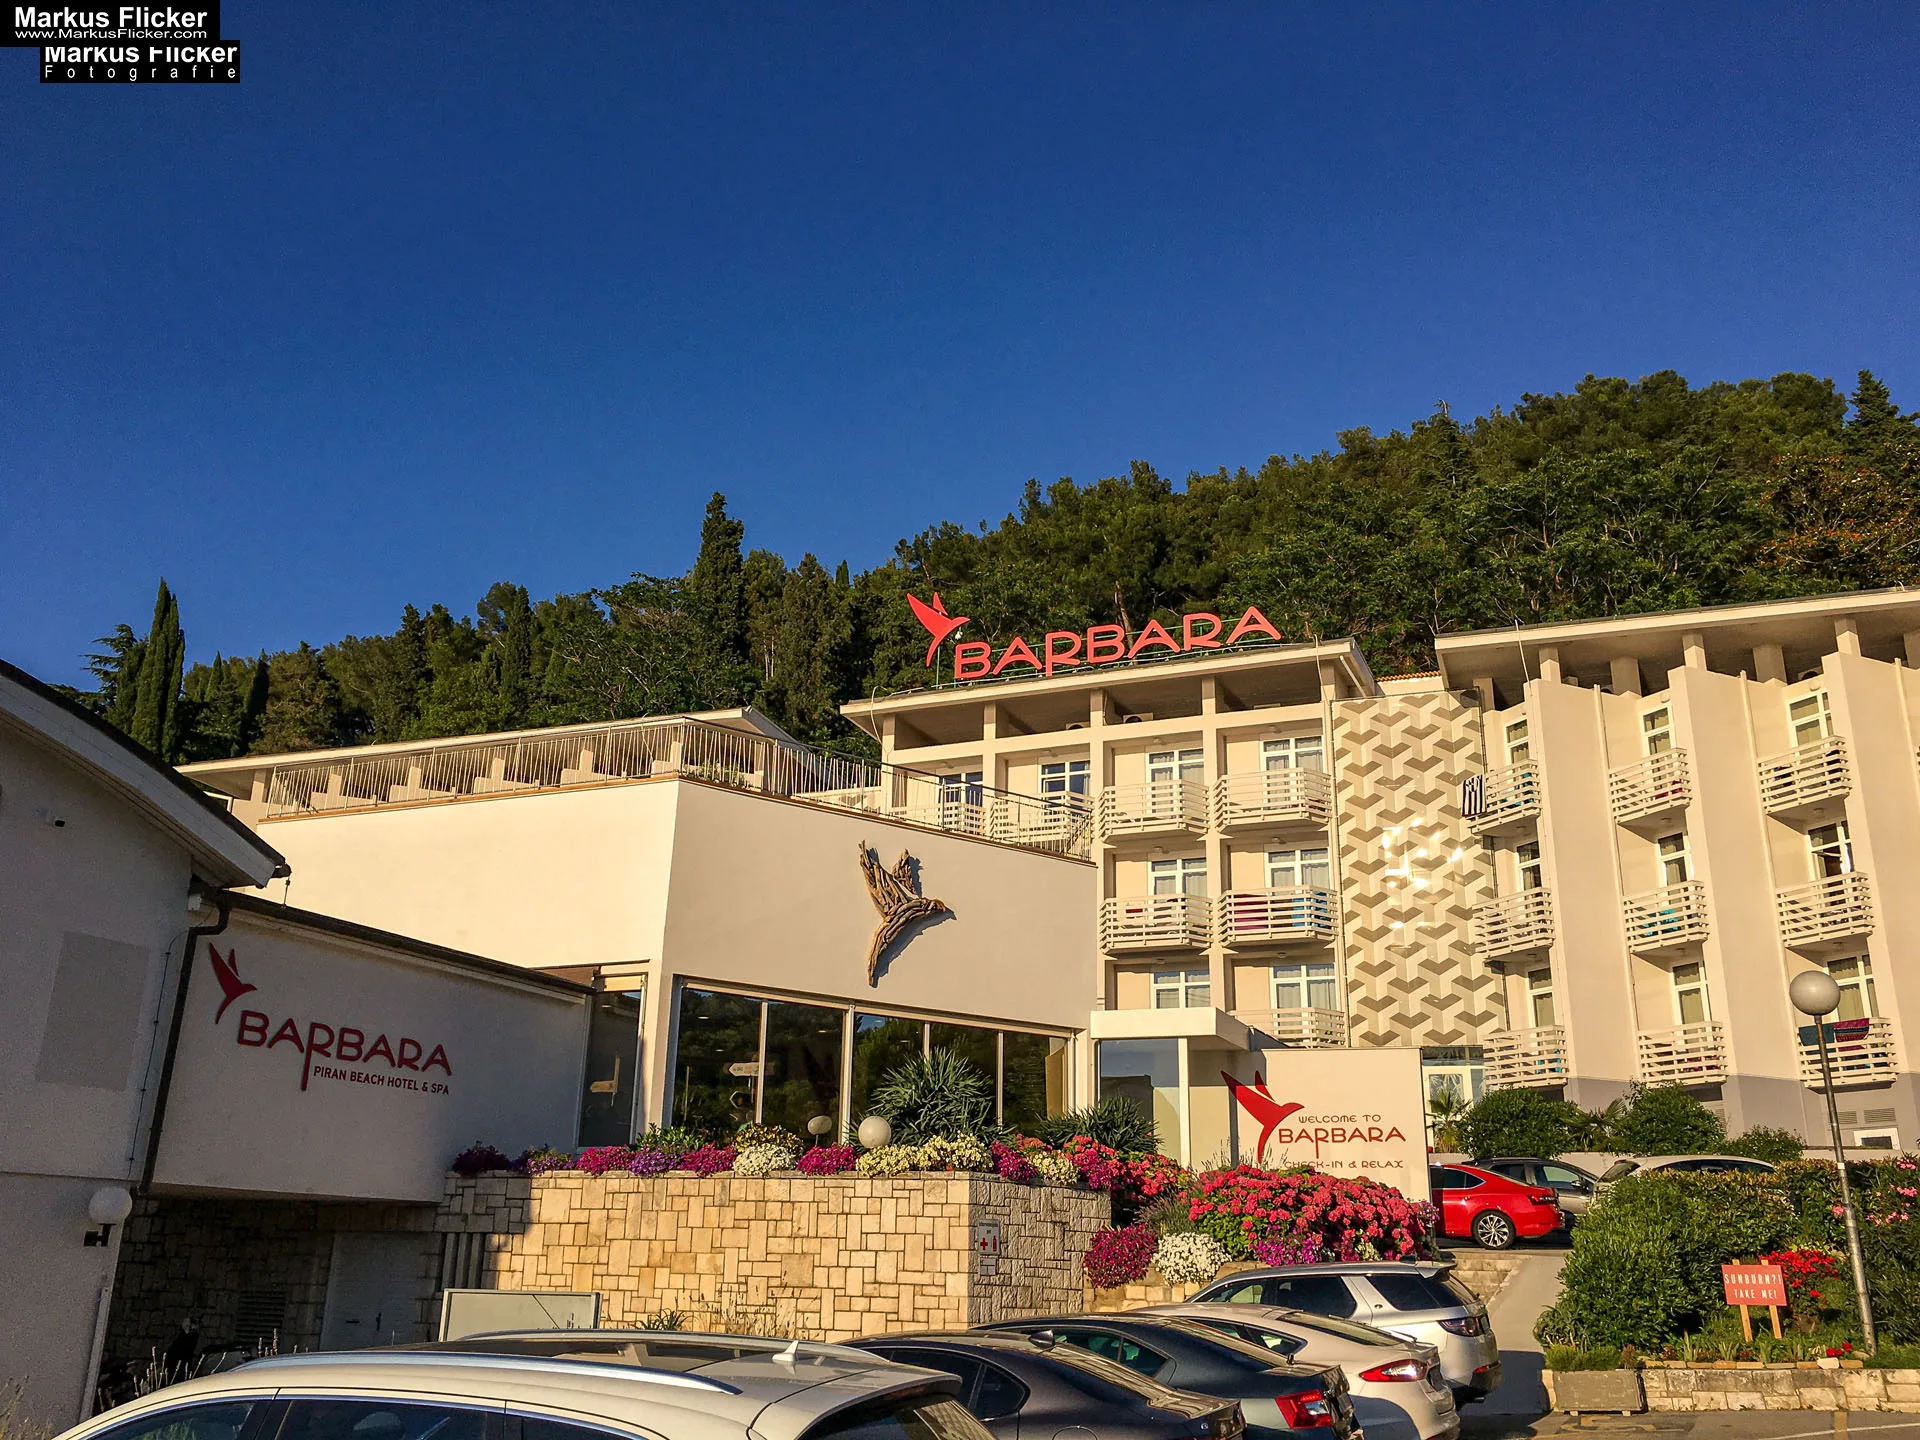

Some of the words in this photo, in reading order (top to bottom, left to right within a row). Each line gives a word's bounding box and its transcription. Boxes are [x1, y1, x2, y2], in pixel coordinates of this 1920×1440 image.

[955, 605, 1282, 678] BARBARA
[237, 1010, 452, 1091] BARBARA
[313, 1065, 347, 1081] PIRAN
[350, 1071, 385, 1086] BEACH
[387, 1077, 419, 1092] HOTEL
[421, 1082, 428, 1092] &
[431, 1083, 449, 1095] SPA
[1298, 1115, 1357, 1123] WELCOME
[1362, 1114, 1382, 1122] TO
[1278, 1126, 1407, 1159] BARBARA
[1724, 1274, 1782, 1284] SUNBURN?!
[1734, 1289, 1755, 1298] TAKE
[1761, 1289, 1777, 1298] ME!
